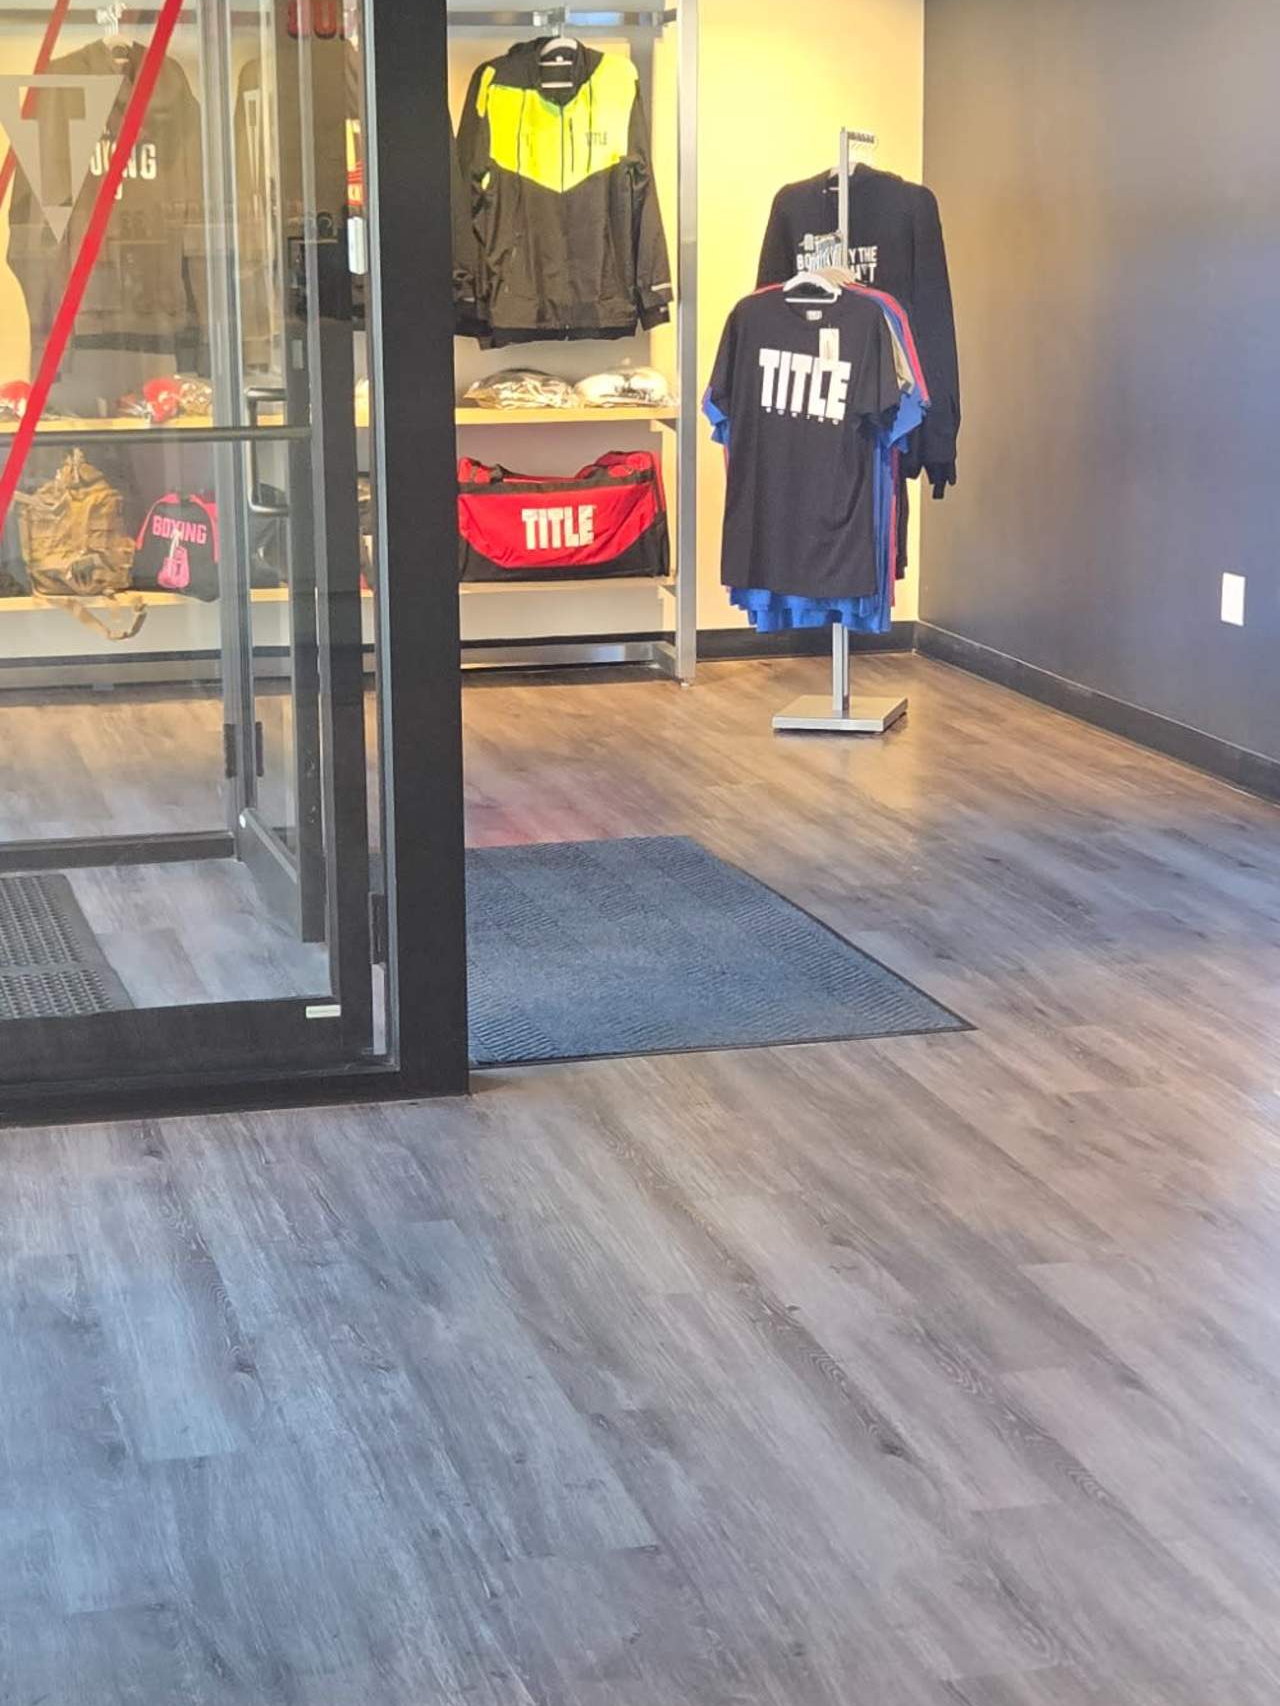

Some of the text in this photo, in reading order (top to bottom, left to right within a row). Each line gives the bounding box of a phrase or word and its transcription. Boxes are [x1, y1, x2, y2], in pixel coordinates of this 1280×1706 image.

[759, 348, 852, 422] TITLE
[152, 514, 207, 544] BOXING
[521, 504, 596, 550] TITLE
